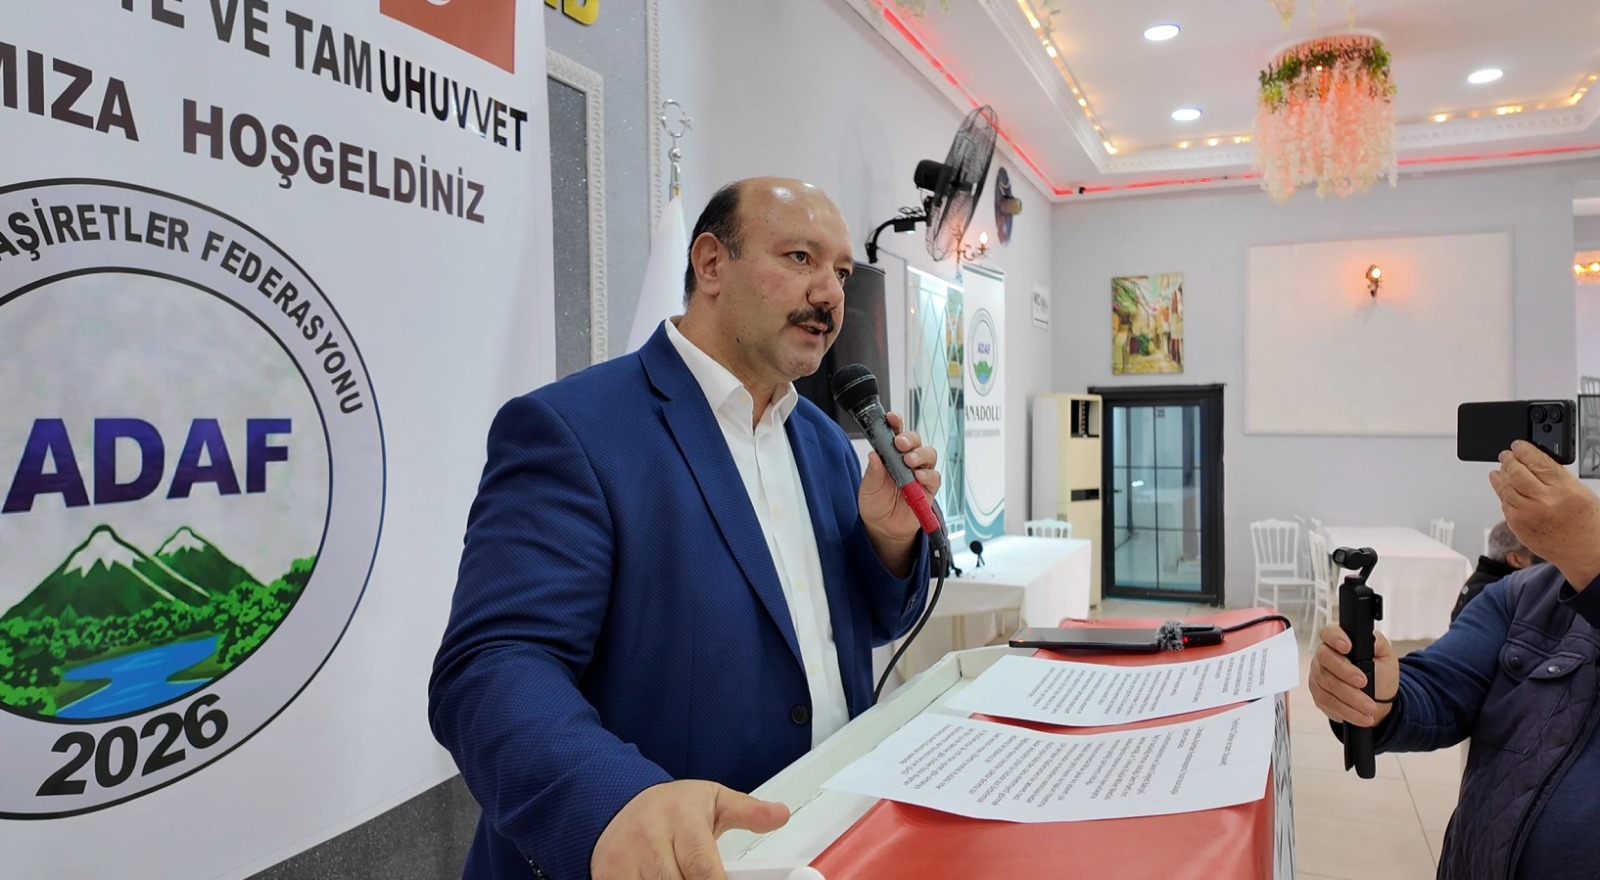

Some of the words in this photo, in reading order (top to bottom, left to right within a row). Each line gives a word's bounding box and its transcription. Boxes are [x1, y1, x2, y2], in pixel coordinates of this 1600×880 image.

[209, 0, 270, 58] VE
[183, 98, 485, 224] HOŞGELDİNİZ
[201, 230, 364, 414] FEDERASYONU
[965, 405, 1001, 421] ANADOLU
[1, 418, 292, 514] ADAF
[35, 693, 229, 797] 2026
